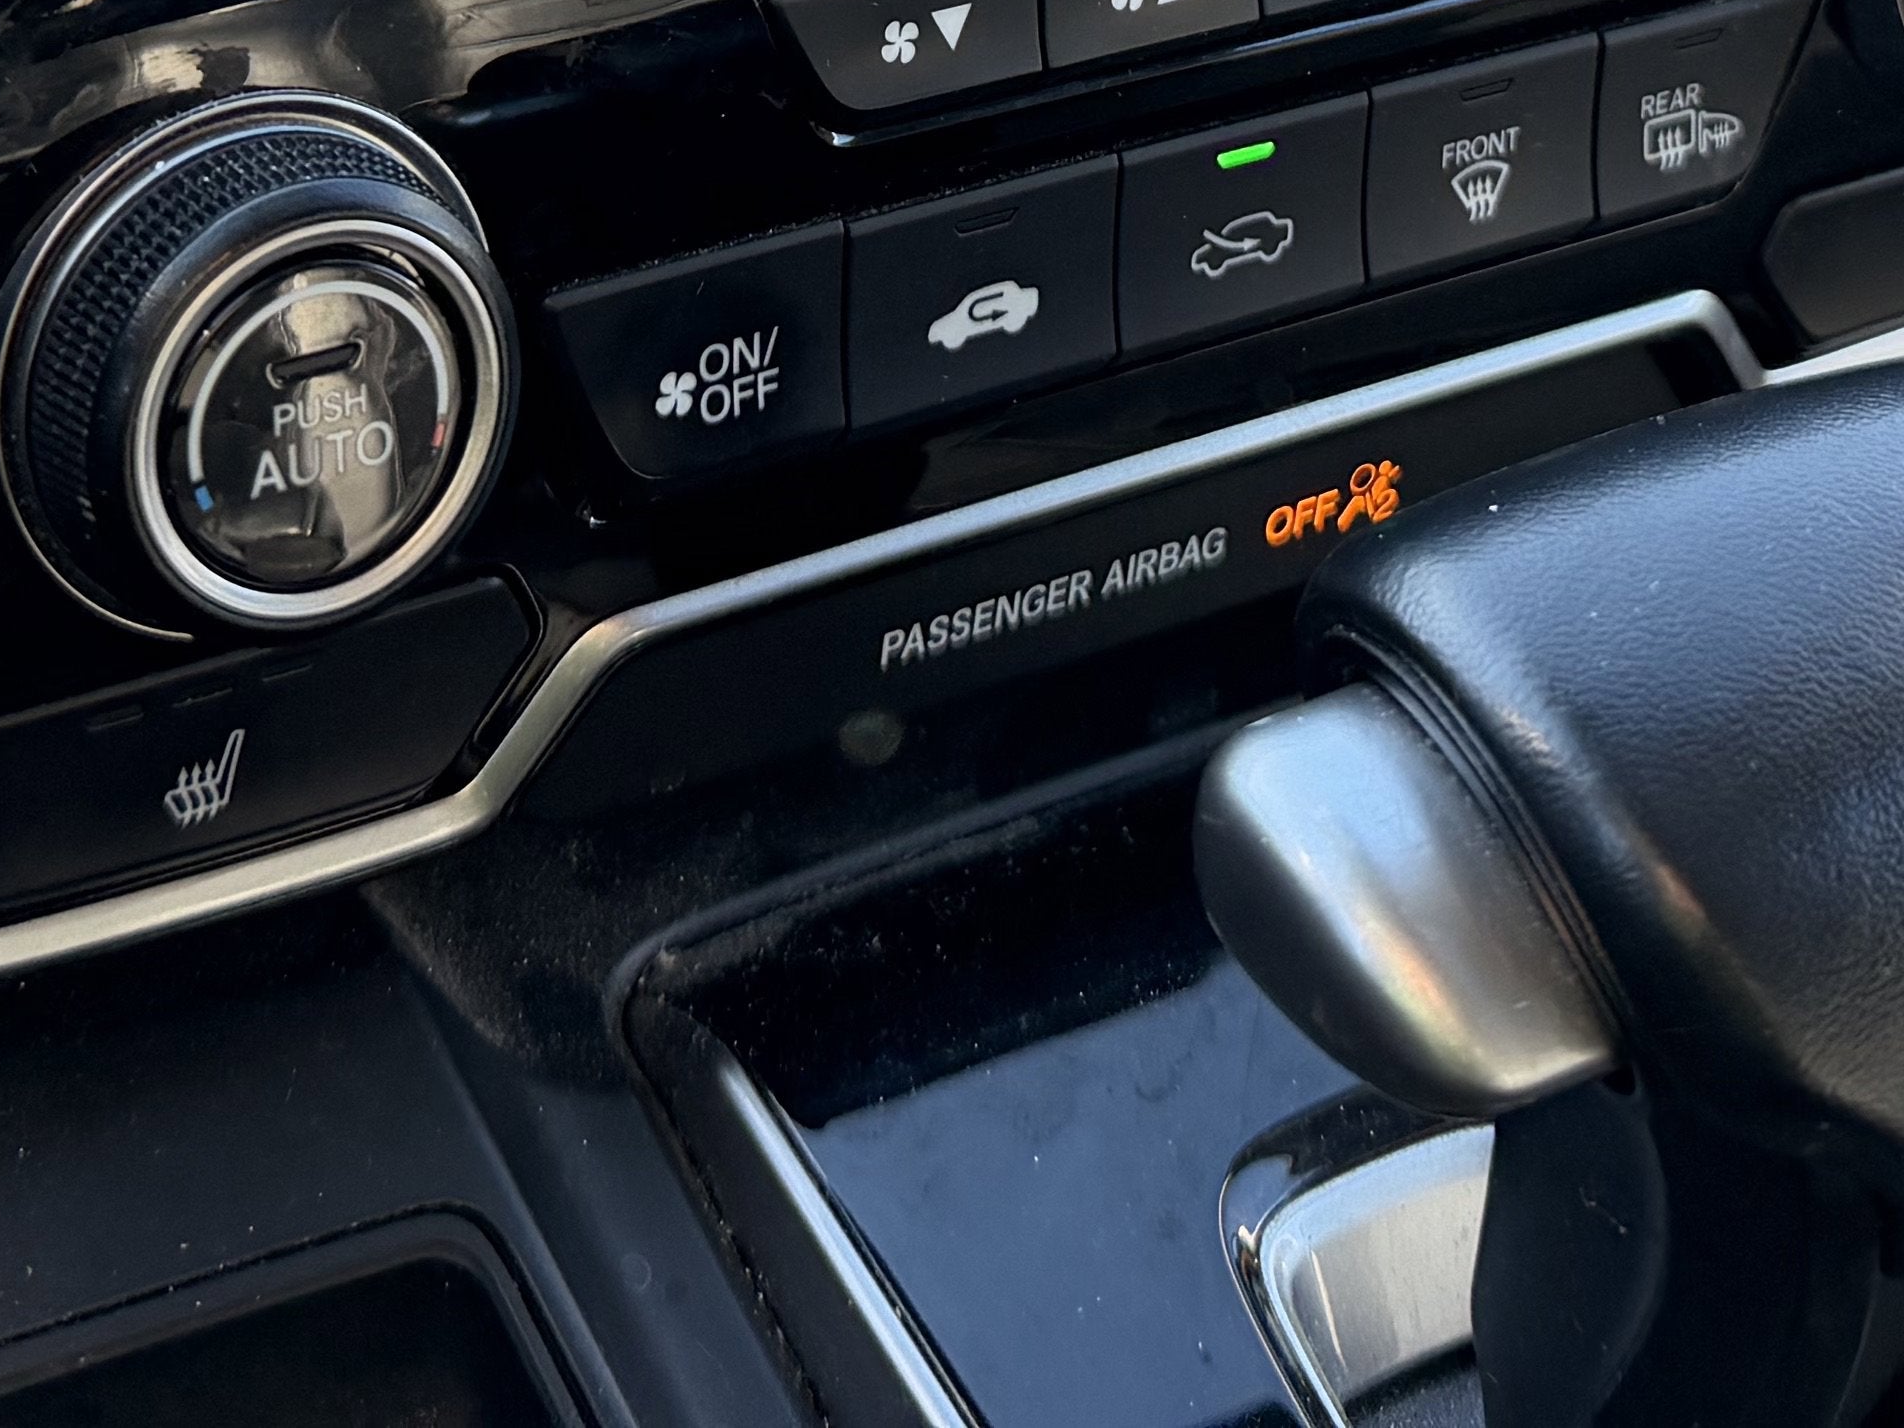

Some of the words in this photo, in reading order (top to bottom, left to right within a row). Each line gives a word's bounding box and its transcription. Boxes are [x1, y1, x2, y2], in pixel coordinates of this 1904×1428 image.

[1640, 83, 1701, 118] REAR
[1442, 126, 1521, 169] FRONT
[273, 384, 367, 437] PUSH
[700, 367, 780, 424] OFF
[250, 419, 394, 500] AUTO
[880, 569, 1093, 672] PASSENGER
[1100, 526, 1229, 598] AIRBAG
[1266, 487, 1342, 547] OFF
